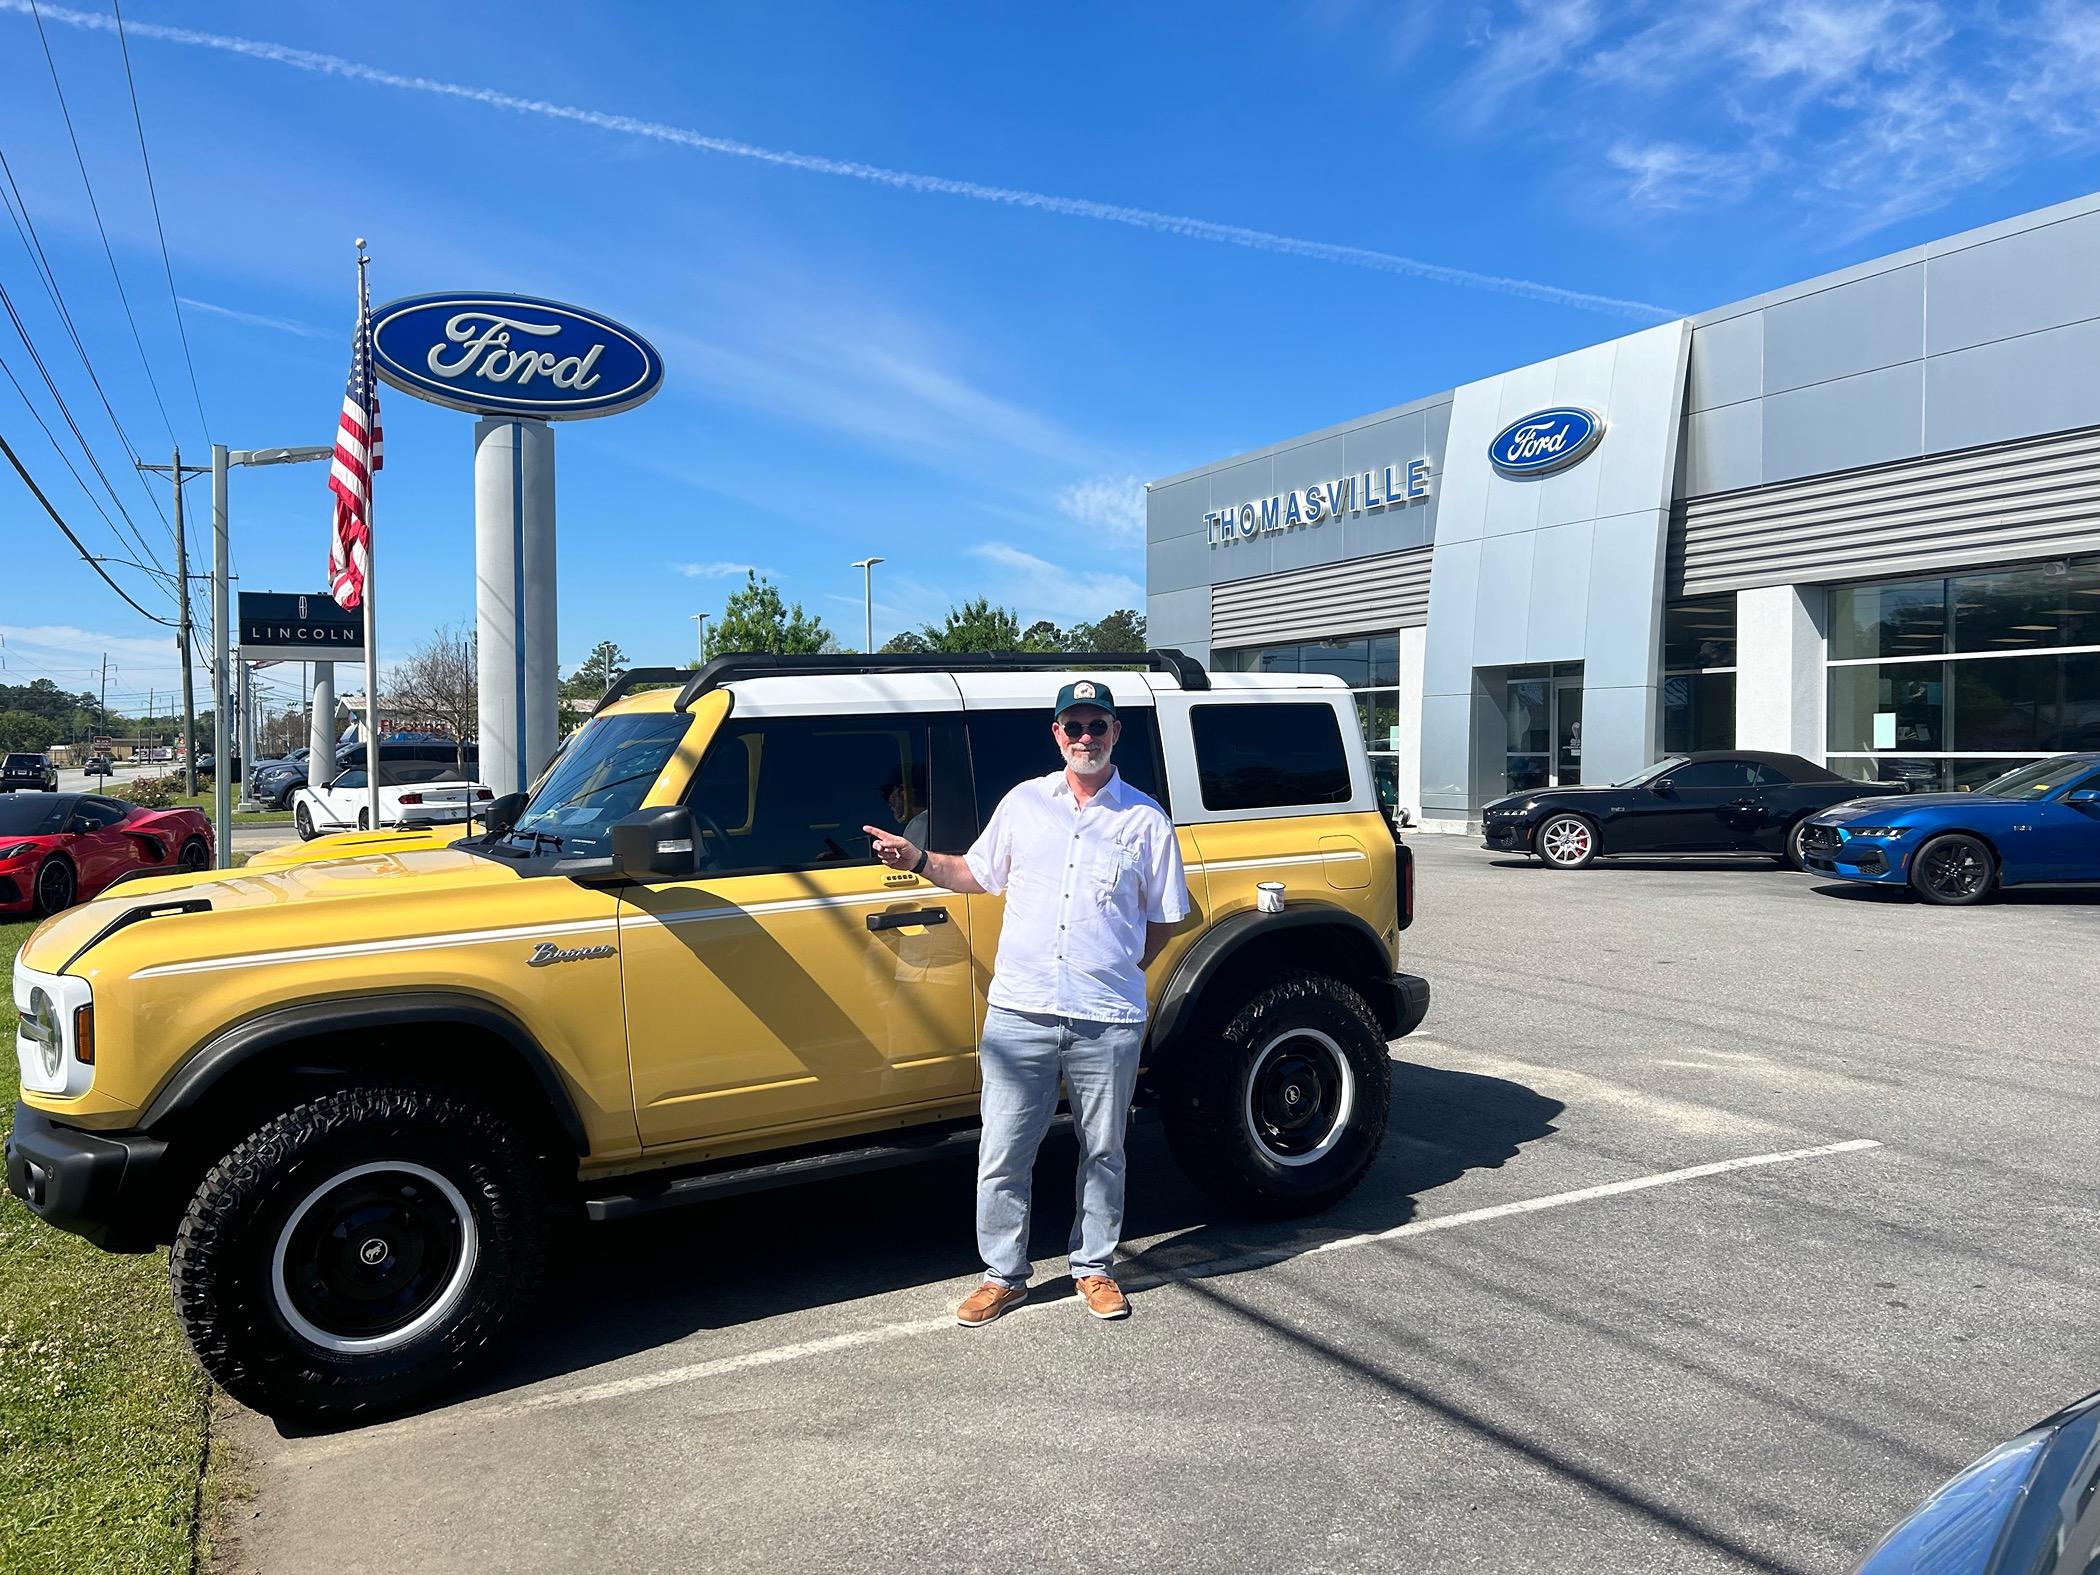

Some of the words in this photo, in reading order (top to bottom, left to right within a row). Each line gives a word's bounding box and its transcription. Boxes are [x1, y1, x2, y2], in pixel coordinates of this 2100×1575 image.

[427, 312, 606, 391] Ford
[1507, 419, 1571, 461] Ford
[1203, 457, 1431, 544] THOMASVILLE
[252, 627, 354, 640] LINCOLN
[525, 942, 618, 967] Bronco
